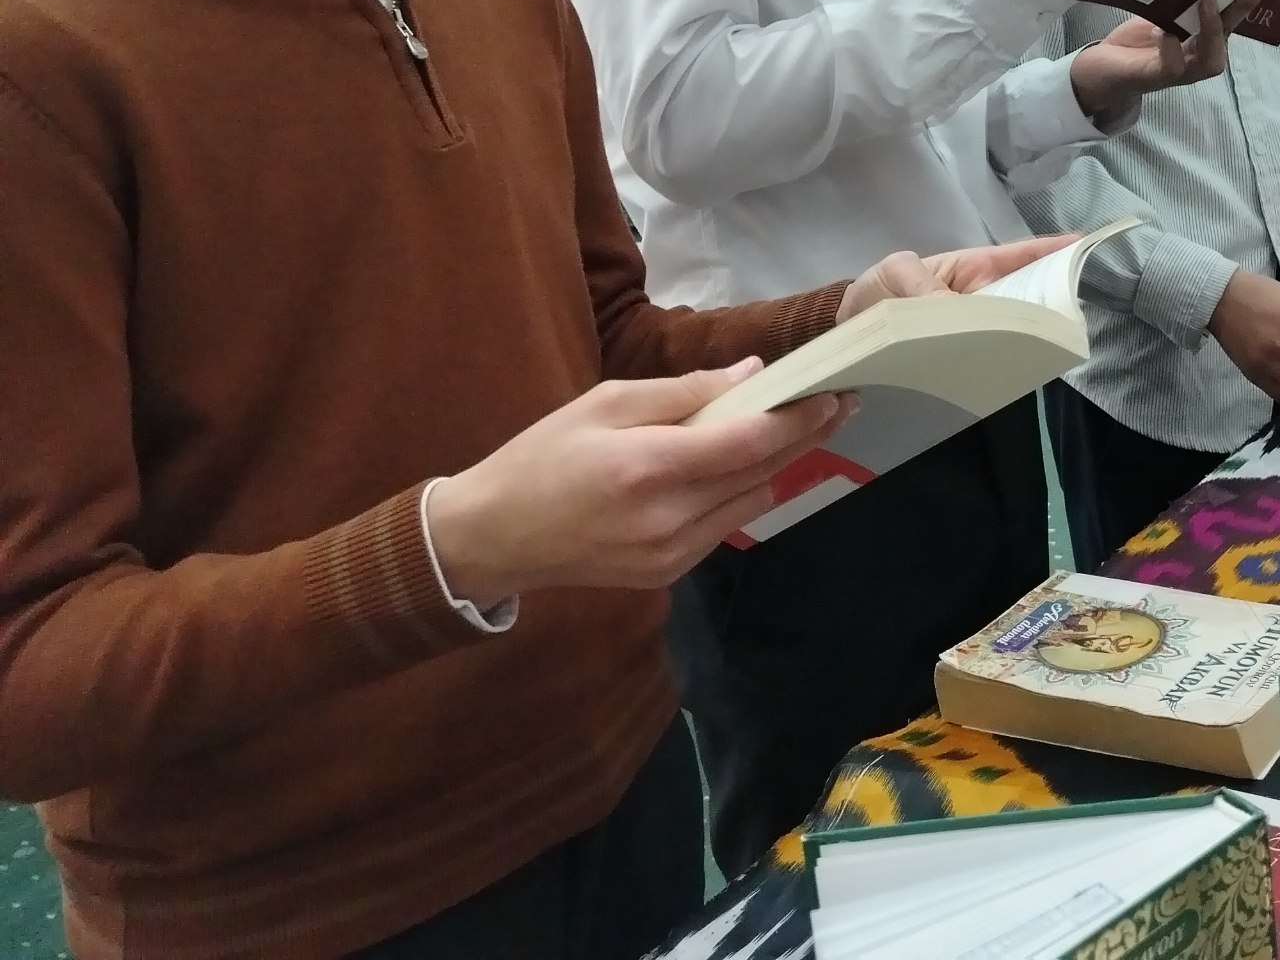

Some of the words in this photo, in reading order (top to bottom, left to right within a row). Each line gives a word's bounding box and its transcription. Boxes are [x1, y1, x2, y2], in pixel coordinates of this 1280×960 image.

[997, 619, 1032, 646] dovoni
[1021, 602, 1063, 640] Avlodlar
[1224, 642, 1248, 654] VA
[1159, 653, 1226, 710] AKBAR
